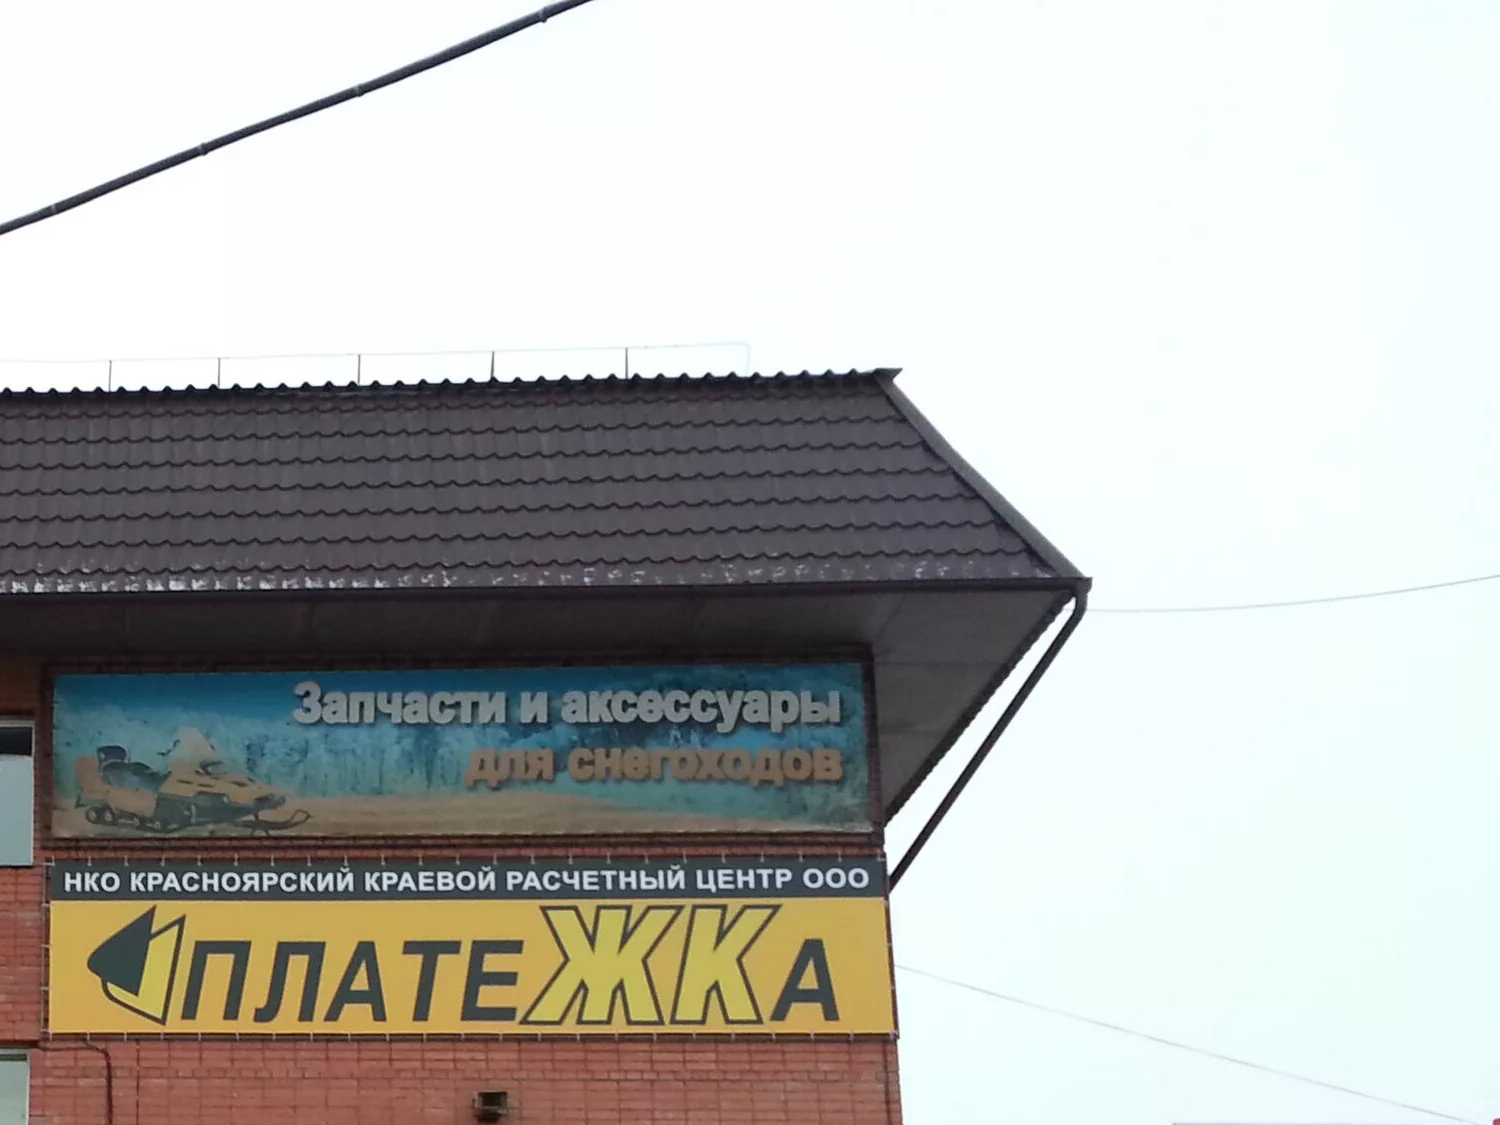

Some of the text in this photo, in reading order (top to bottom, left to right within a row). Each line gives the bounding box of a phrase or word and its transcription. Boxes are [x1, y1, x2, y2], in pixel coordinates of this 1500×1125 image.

[292, 681, 841, 733] Запчасти и аксессуары
[464, 745, 842, 792] для снегоходов
[63, 863, 871, 897] НКО КРАСНОЯРСКИЙ КРАЕВОЙ РАСЧЕТНЫЙ ЦЕНТР ООО
[180, 904, 842, 1026] ПЛАТЕЖКА
